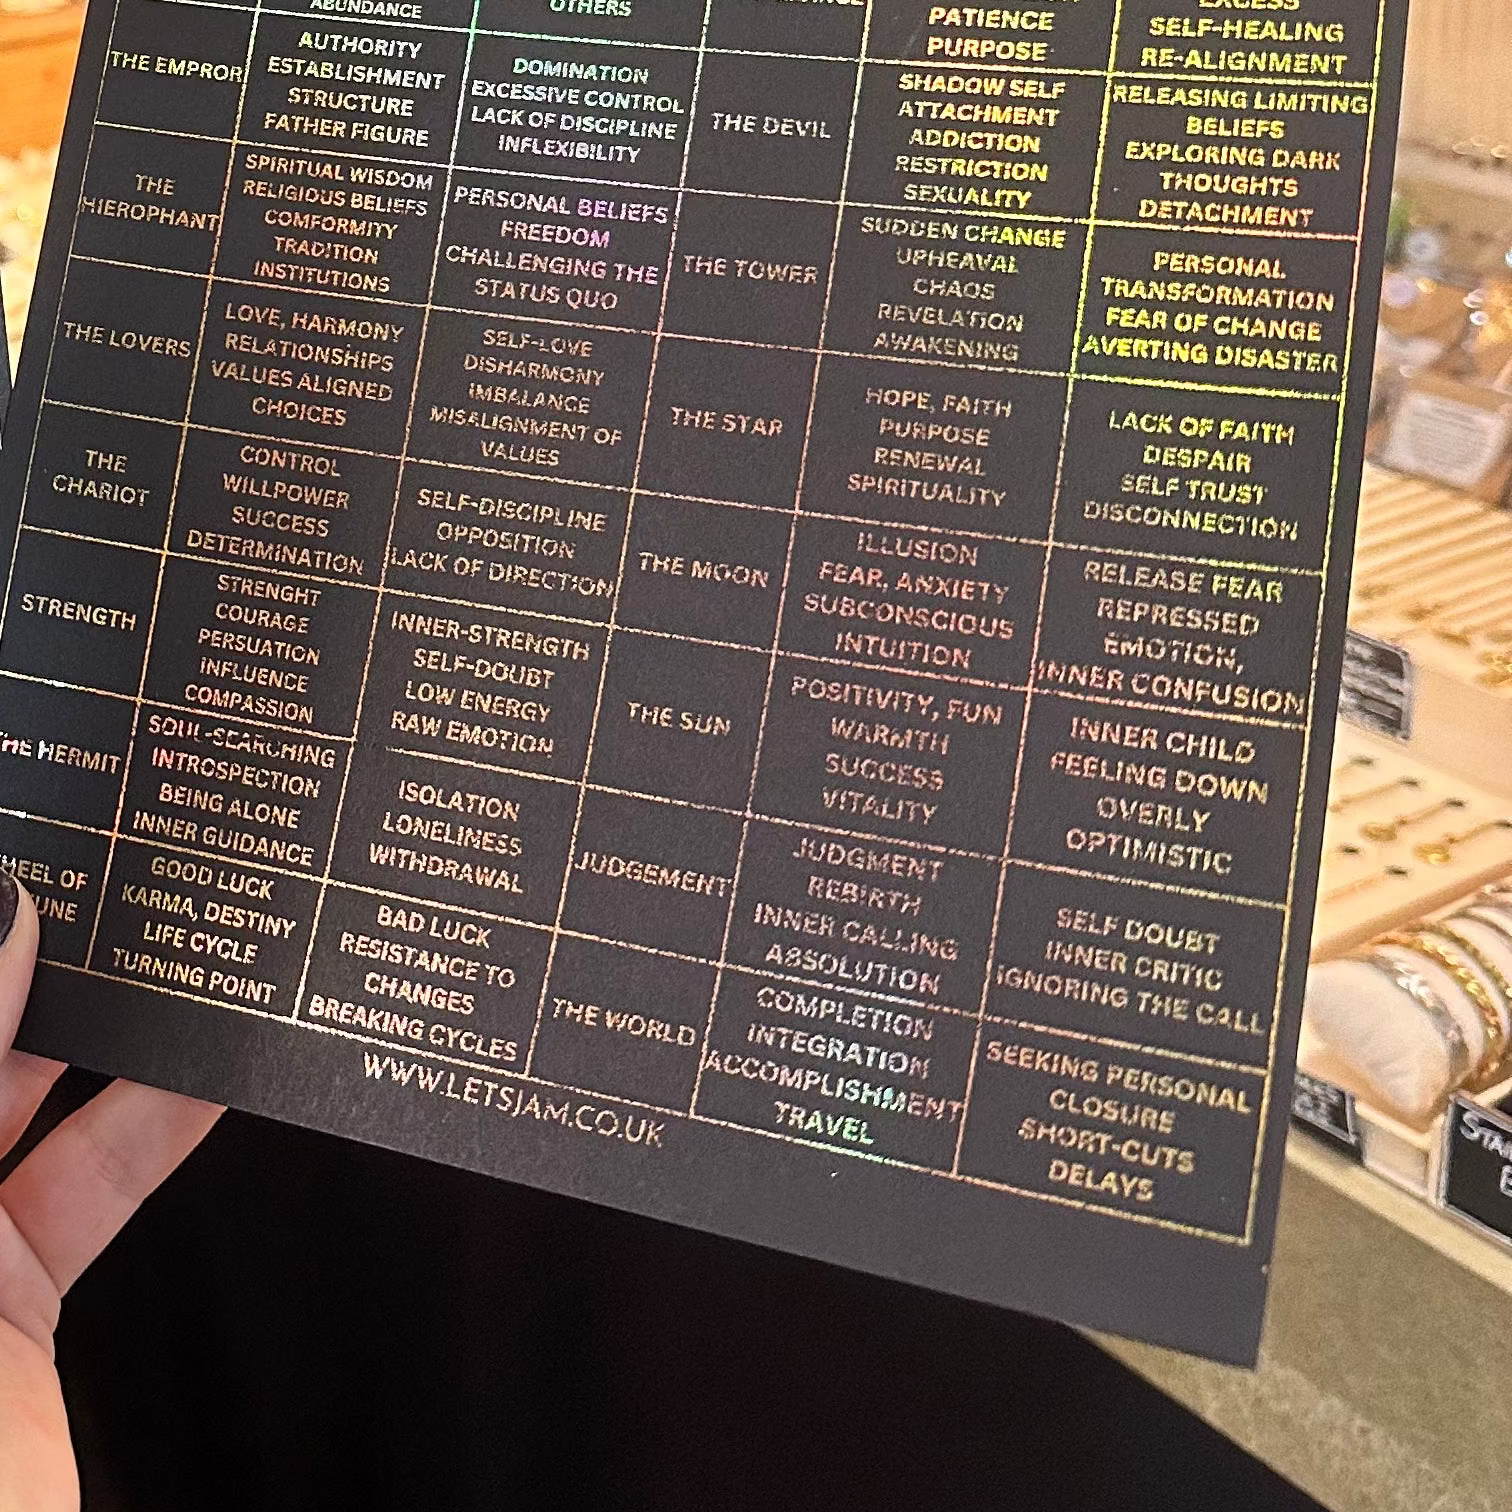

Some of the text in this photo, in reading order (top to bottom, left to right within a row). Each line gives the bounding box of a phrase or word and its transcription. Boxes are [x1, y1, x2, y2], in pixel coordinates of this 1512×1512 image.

[298, 31, 422, 58] AUTHORITY
[1149, 16, 1343, 42] SELF-HEALING
[112, 50, 242, 82] THE EMPROR
[512, 58, 648, 83] DOMINATION
[712, 112, 830, 138] THE DEVIL
[898, 100, 1060, 125] ATTACHMENT
[245, 154, 432, 190] SPIRITUAL WISDOM
[82, 196, 217, 230] HIEROPHANT
[1138, 199, 1313, 226] DETACHMENT
[500, 220, 609, 248] FREEDOM
[861, 216, 1066, 248] SUDDEN CHANGE
[684, 255, 817, 283] THE TOWER
[1153, 251, 1286, 278] PERSONAL
[63, 321, 190, 357] THE LOVERS
[464, 354, 604, 385] DISHARMONY
[252, 396, 346, 425] CHOICES
[671, 406, 782, 436] THE STAR
[85, 449, 127, 472] THE
[1143, 445, 1251, 473] DESPAIR
[417, 488, 607, 531] SELF-DISCIPLINE
[186, 528, 363, 575] DETERMINATION
[639, 551, 768, 587] THE MOON
[21, 593, 135, 630] STRENGTH
[803, 593, 1013, 639] SUBCONSCIOUS
[184, 683, 312, 723] COMPASSION
[1038, 660, 1304, 715] INNER CONFUSION
[628, 701, 730, 735] THE SUN
[946, 698, 1002, 724] FUN
[391, 710, 553, 752] RAW EMOTION
[1070, 716, 1255, 764] INNER CHILD
[37, 740, 120, 773] HERMIT
[152, 746, 320, 797] INTROSPECTION
[370, 843, 523, 893] WITHDRAWAL
[574, 851, 731, 897] JUDGEMENT
[143, 921, 257, 963] LIFE CYCLE
[765, 943, 940, 994] ABSOLUTION
[364, 972, 474, 1015] CHANGES
[553, 998, 695, 1046] THE WORLD
[364, 1052, 664, 1147] WWW.LETSJAM.CO.UK
[774, 1100, 873, 1144] TRAVEL
[1048, 1158, 1153, 1201] DELAYS
